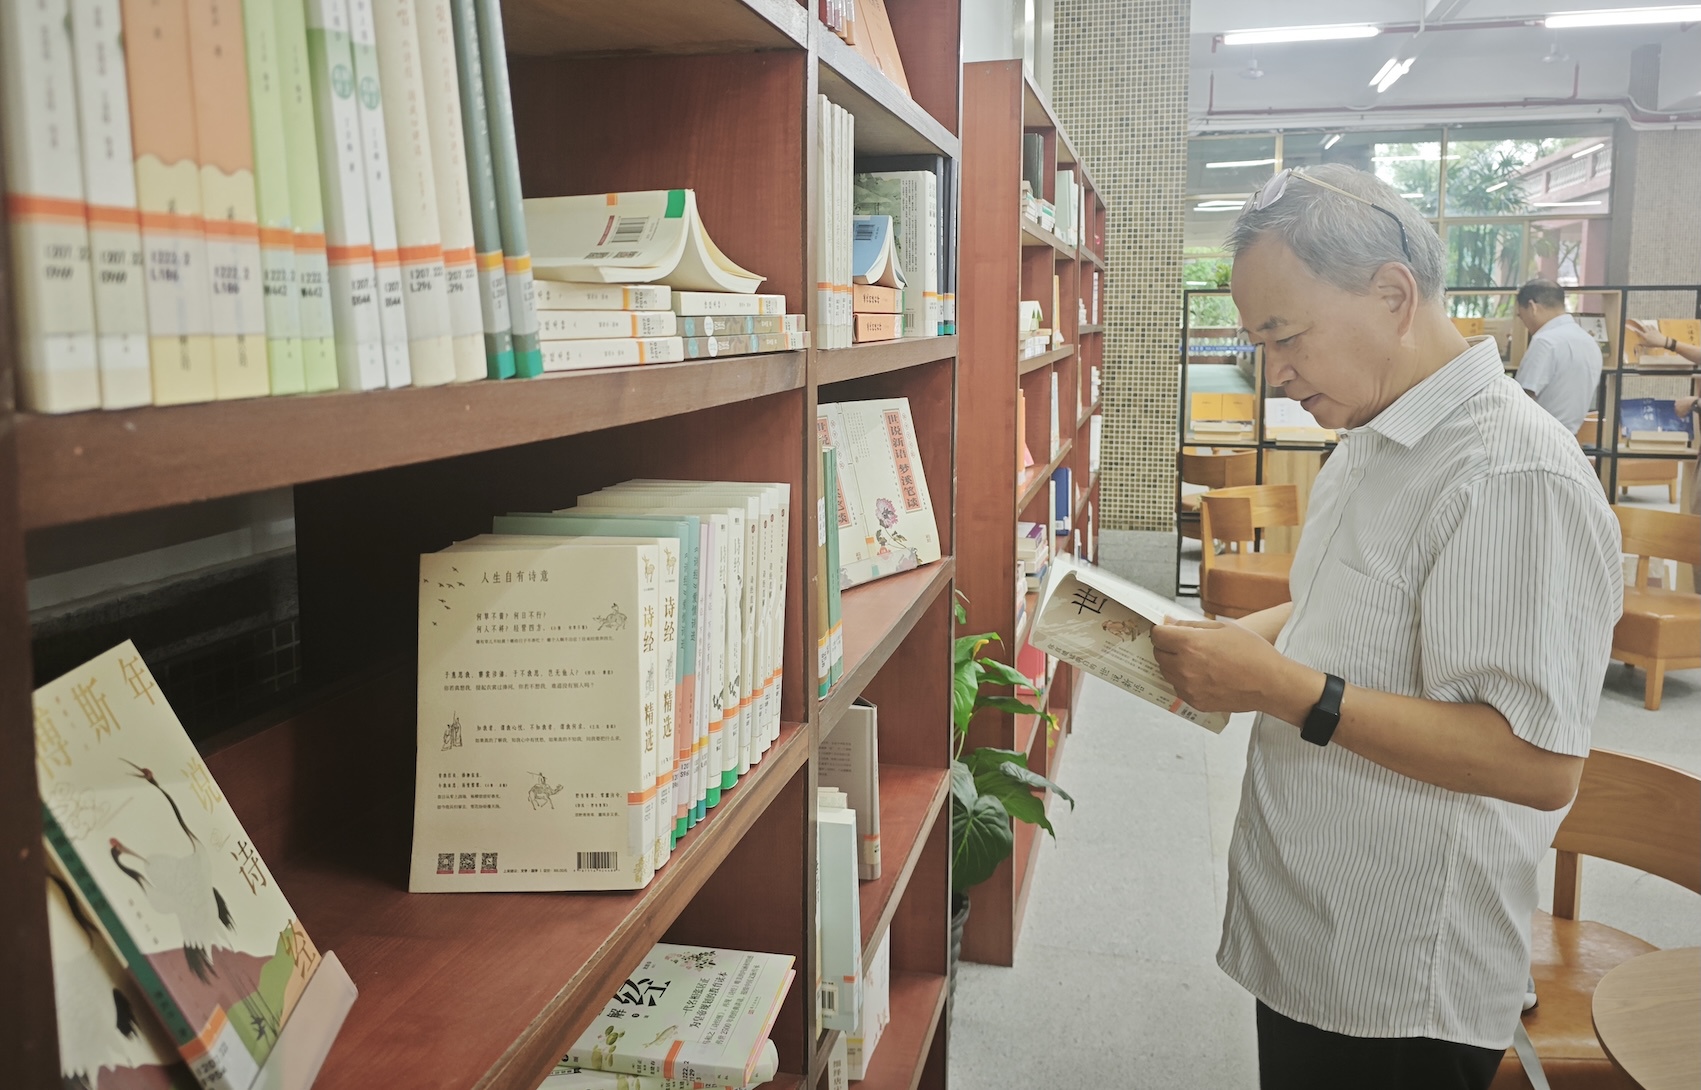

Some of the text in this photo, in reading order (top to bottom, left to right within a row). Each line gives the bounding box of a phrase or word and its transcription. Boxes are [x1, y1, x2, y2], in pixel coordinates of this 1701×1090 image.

[887, 413, 919, 508] 世说新语 梦溪笔谈
[481, 569, 549, 584] 人生自有诗意
[1071, 586, 1108, 615] 世
[643, 605, 655, 754] 诗经 精选
[662, 596, 675, 739] 诗经 精选
[1099, 666, 1145, 694] 世说新语
[181, 756, 317, 980] 说诗经
[690, 971, 728, 1030] 为皇帝规划的教育读本
